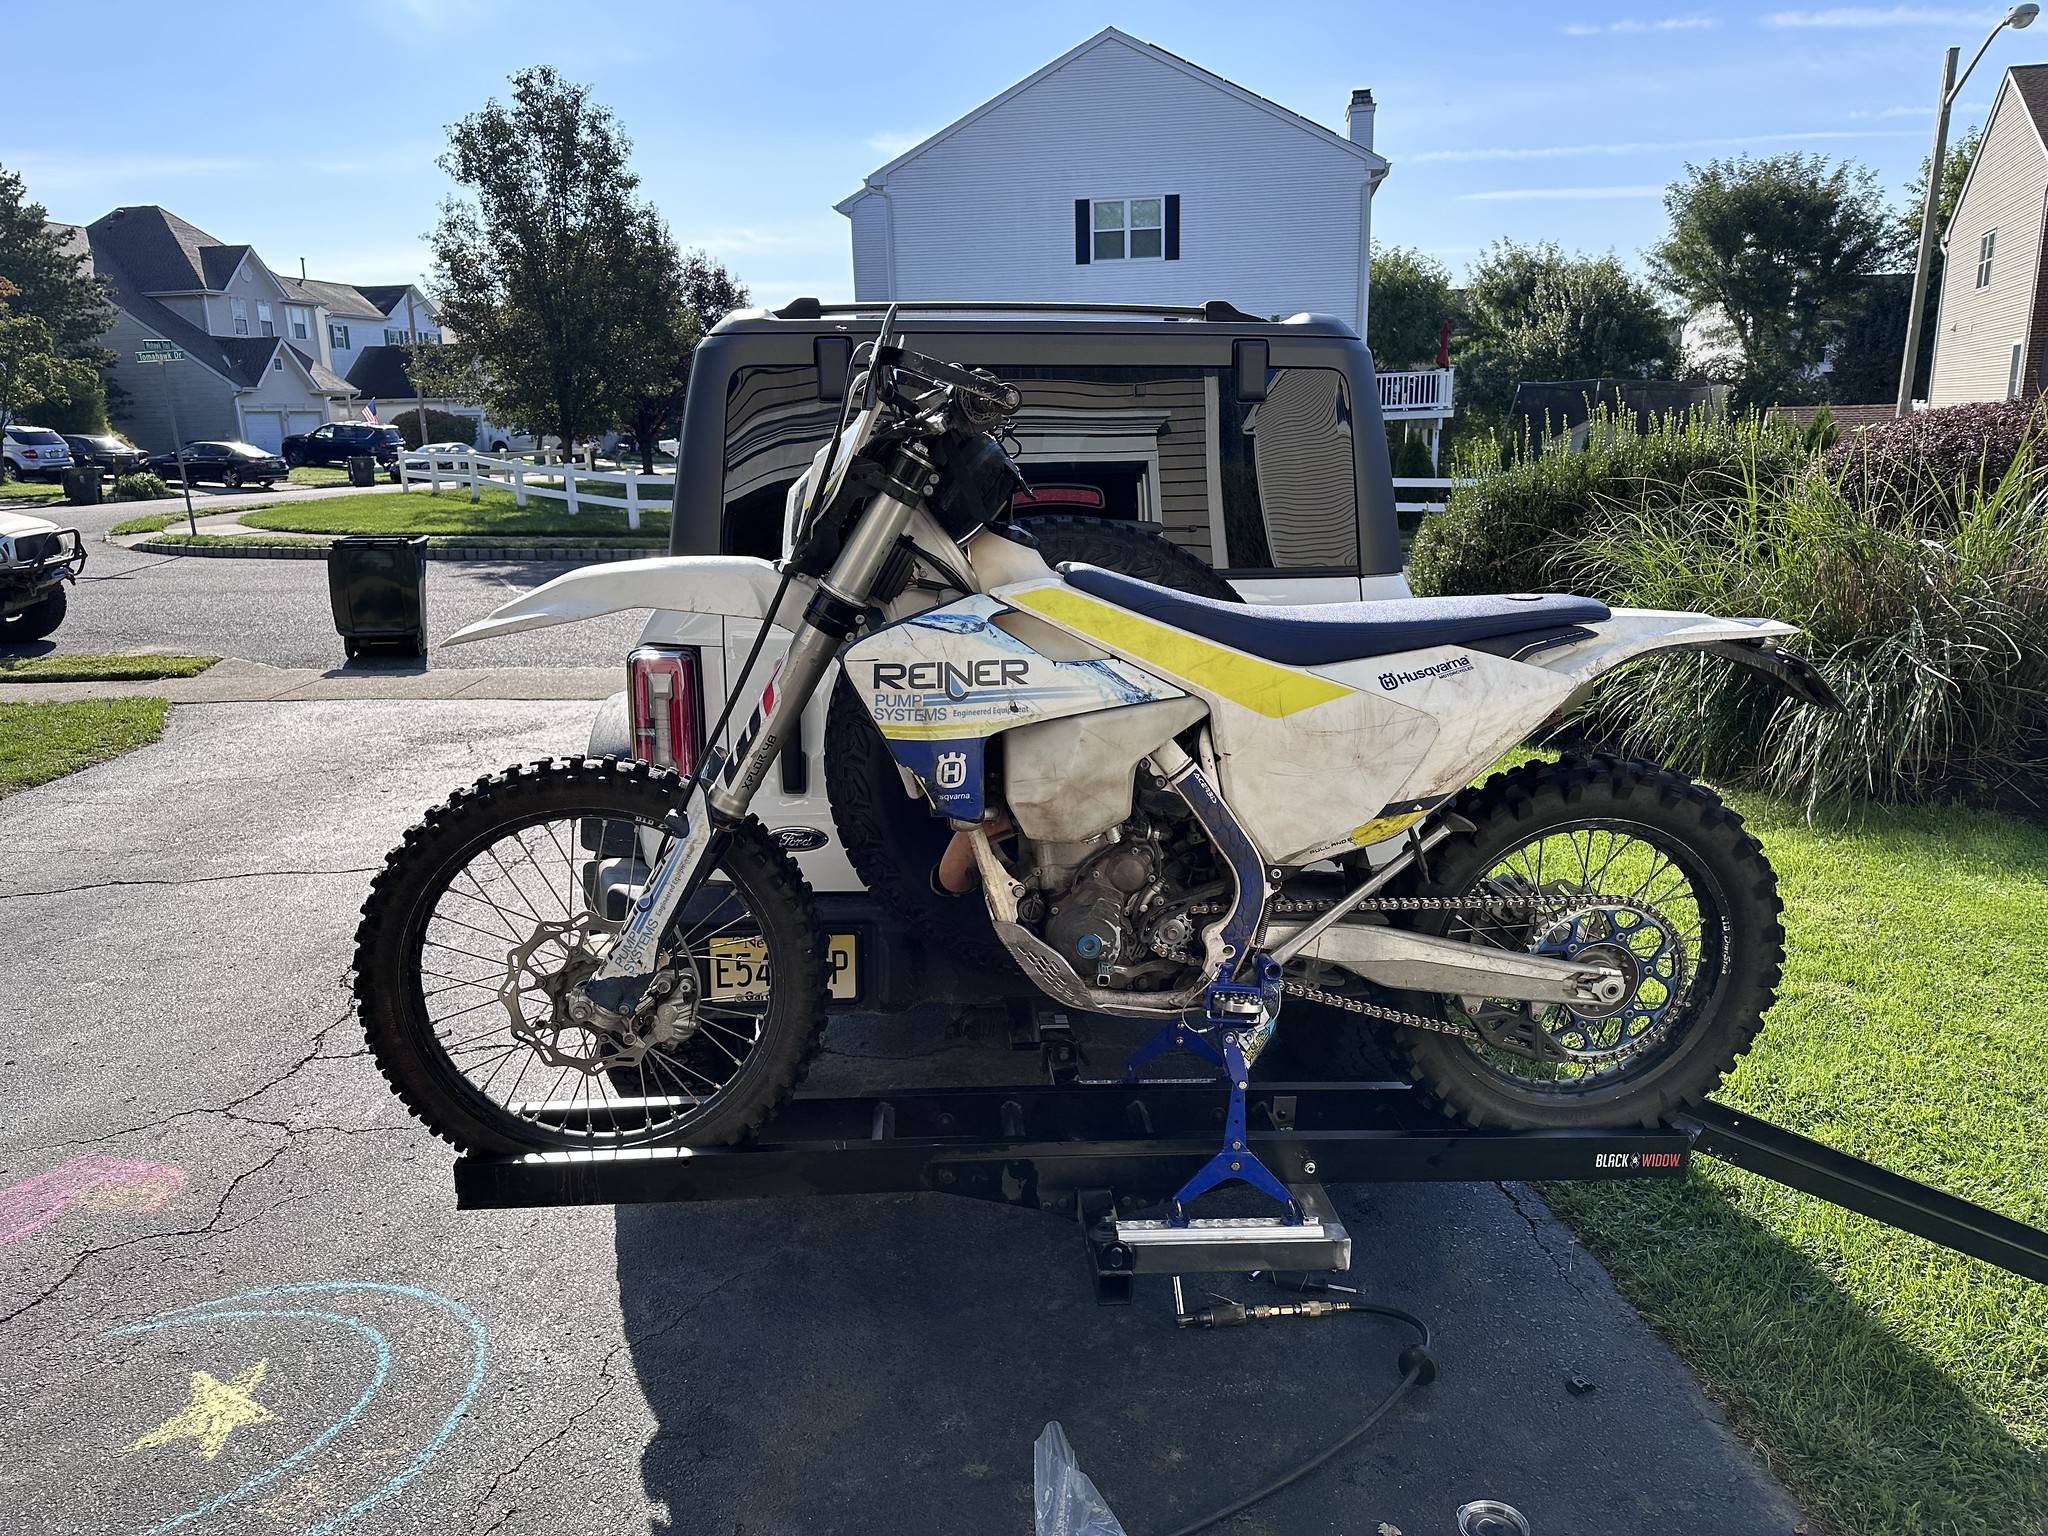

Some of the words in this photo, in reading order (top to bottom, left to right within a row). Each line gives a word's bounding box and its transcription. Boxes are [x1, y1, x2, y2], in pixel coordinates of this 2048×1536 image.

[139, 352, 172, 360] Tomahawk
[1397, 656, 1470, 684] Husqvarna
[873, 659, 1029, 701] REINER
[875, 694, 922, 708] PUMP
[874, 707, 947, 721] SYSTEMS
[953, 708, 992, 718] Engineered
[742, 754, 768, 790] XPLOR
[762, 735, 777, 751] 48
[778, 832, 813, 847] Ford
[1309, 845, 1330, 855] PULL
[1331, 839, 1347, 848] AND
[615, 931, 638, 967] PUMP
[624, 919, 659, 974] SYSTEMS
[1595, 1153, 1629, 1168] BLACK
[1642, 1153, 1680, 1167] WIDOW
